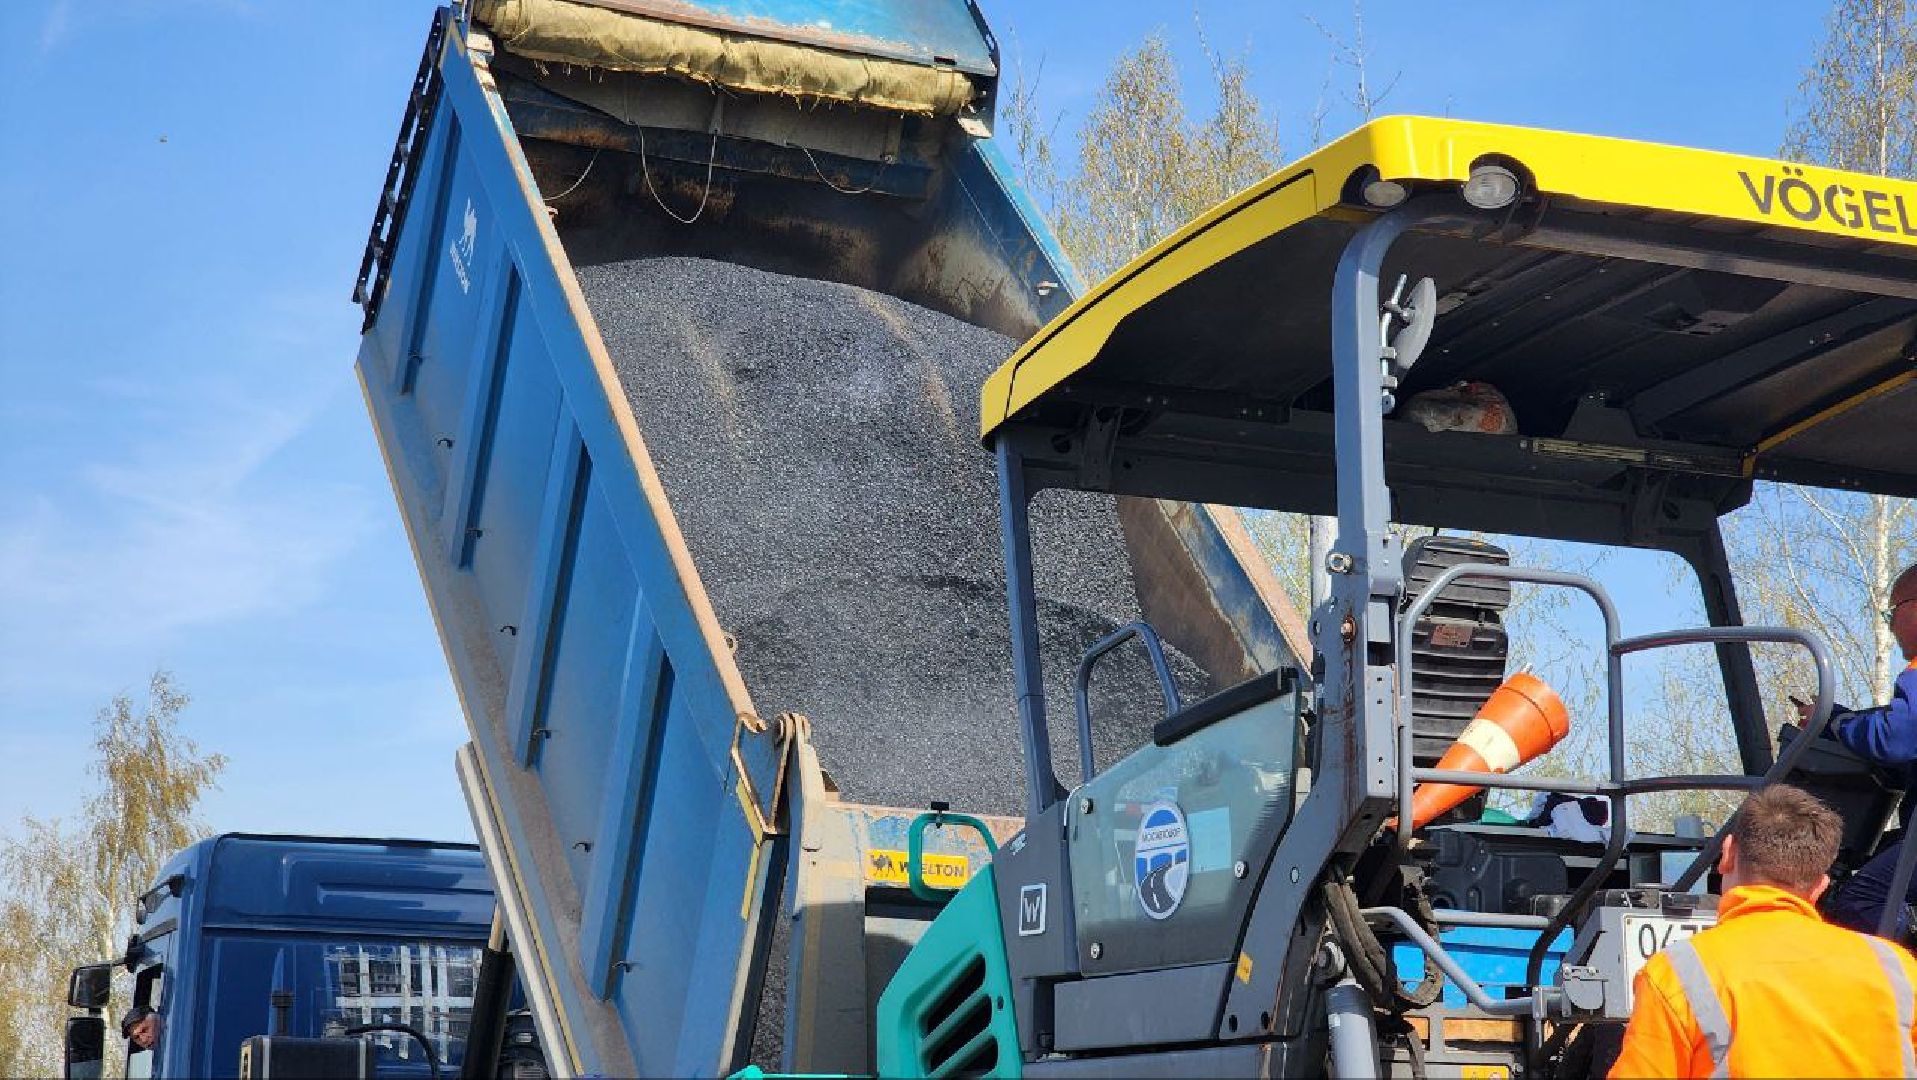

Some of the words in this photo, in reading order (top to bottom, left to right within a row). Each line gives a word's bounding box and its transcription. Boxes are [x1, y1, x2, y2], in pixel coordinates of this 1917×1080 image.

[1737, 165, 1917, 236] VÖGEL
[899, 861, 965, 877] WELTON
[1023, 896, 1041, 923] W
